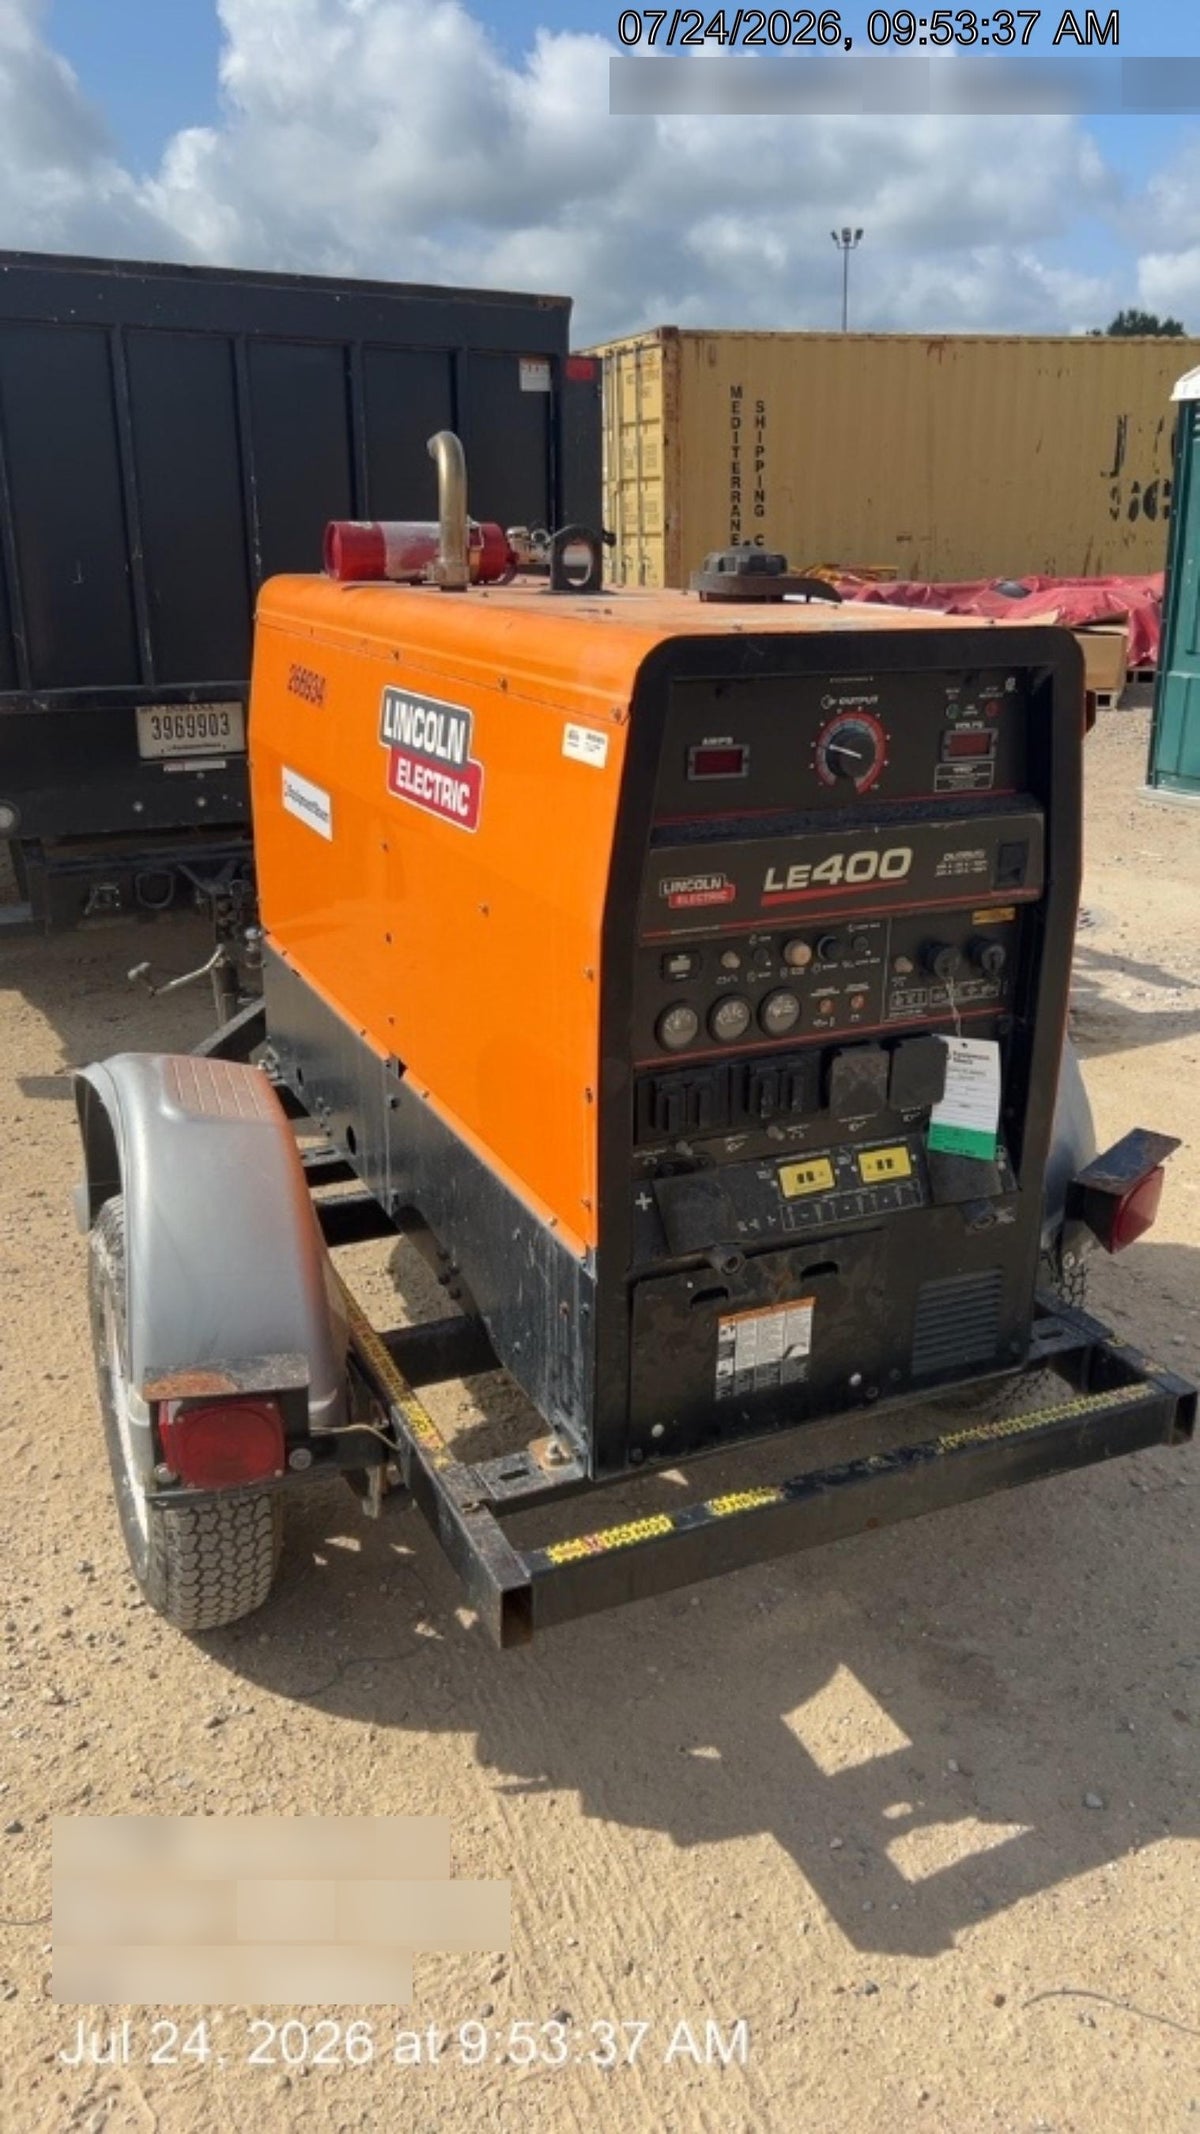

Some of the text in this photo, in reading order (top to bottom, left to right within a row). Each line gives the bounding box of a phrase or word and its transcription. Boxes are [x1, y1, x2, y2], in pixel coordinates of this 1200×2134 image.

[753, 400, 767, 518] SHIPPING
[150, 712, 231, 741] 3969903
[383, 697, 466, 765] LINCOLN
[395, 756, 471, 818] ELECTRIC
[663, 876, 722, 895] LINCOLN
[763, 847, 913, 893] LE400
[676, 889, 729, 905] ELECTRIC
